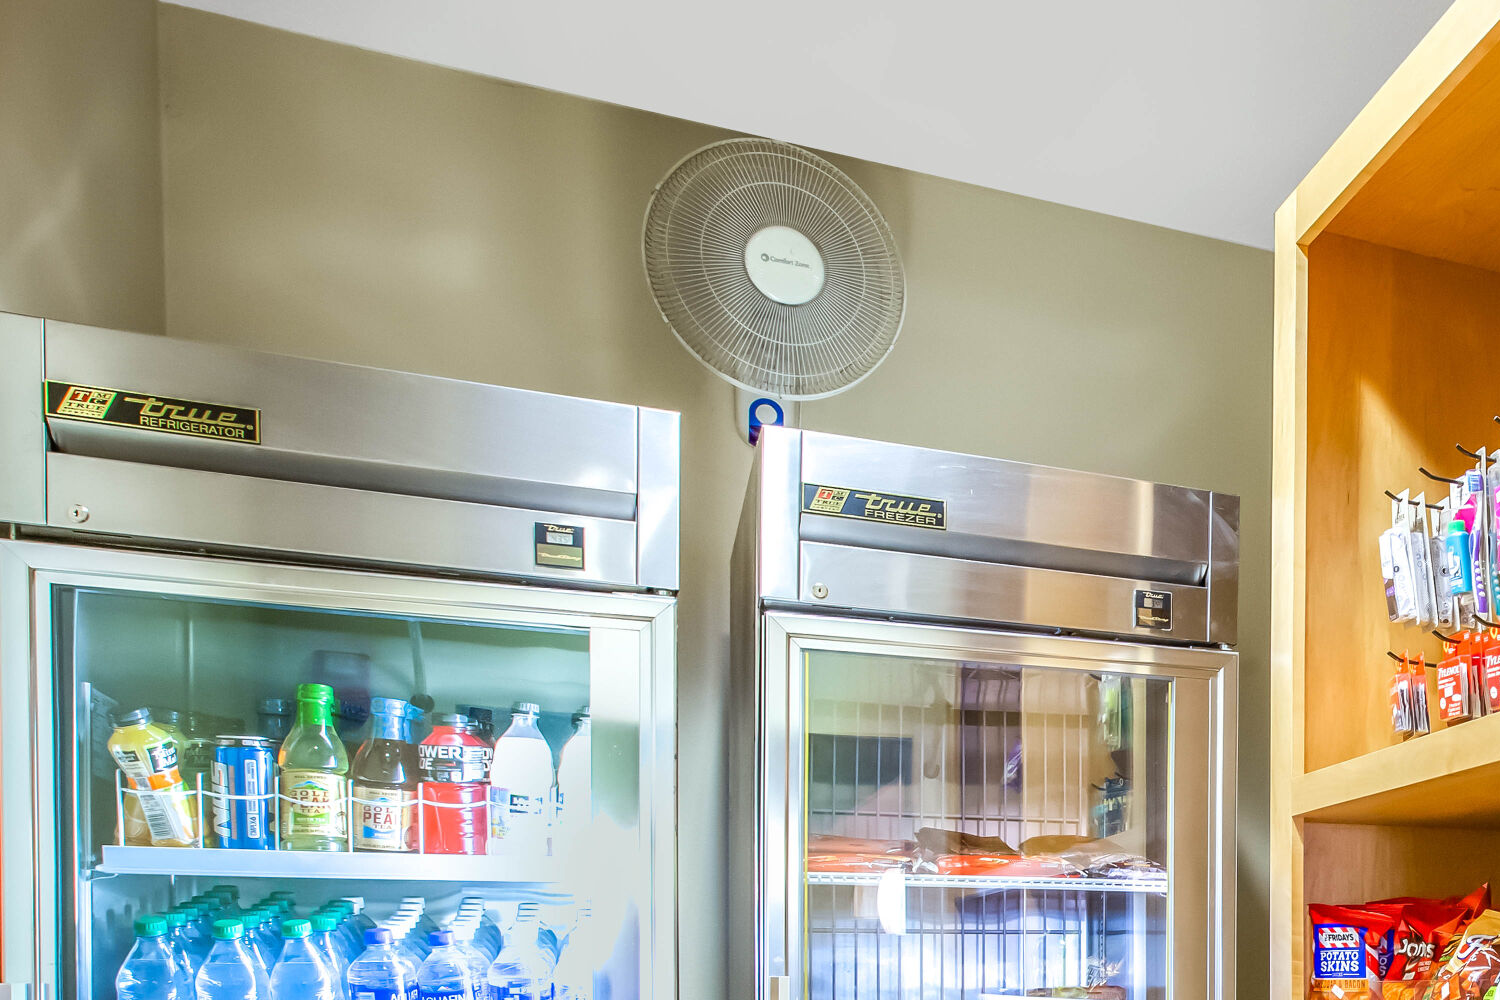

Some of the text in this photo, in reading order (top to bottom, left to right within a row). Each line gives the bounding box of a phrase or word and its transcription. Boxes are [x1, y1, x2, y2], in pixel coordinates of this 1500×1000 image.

[124, 397, 246, 427] true
[140, 416, 245, 438] REFRIGERATOR
[855, 494, 936, 516] true
[865, 509, 936, 525] FREEZER
[1328, 932, 1354, 942] FRIDAYS
[1320, 951, 1359, 961] POTATO
[1320, 960, 1359, 972] SKINS
